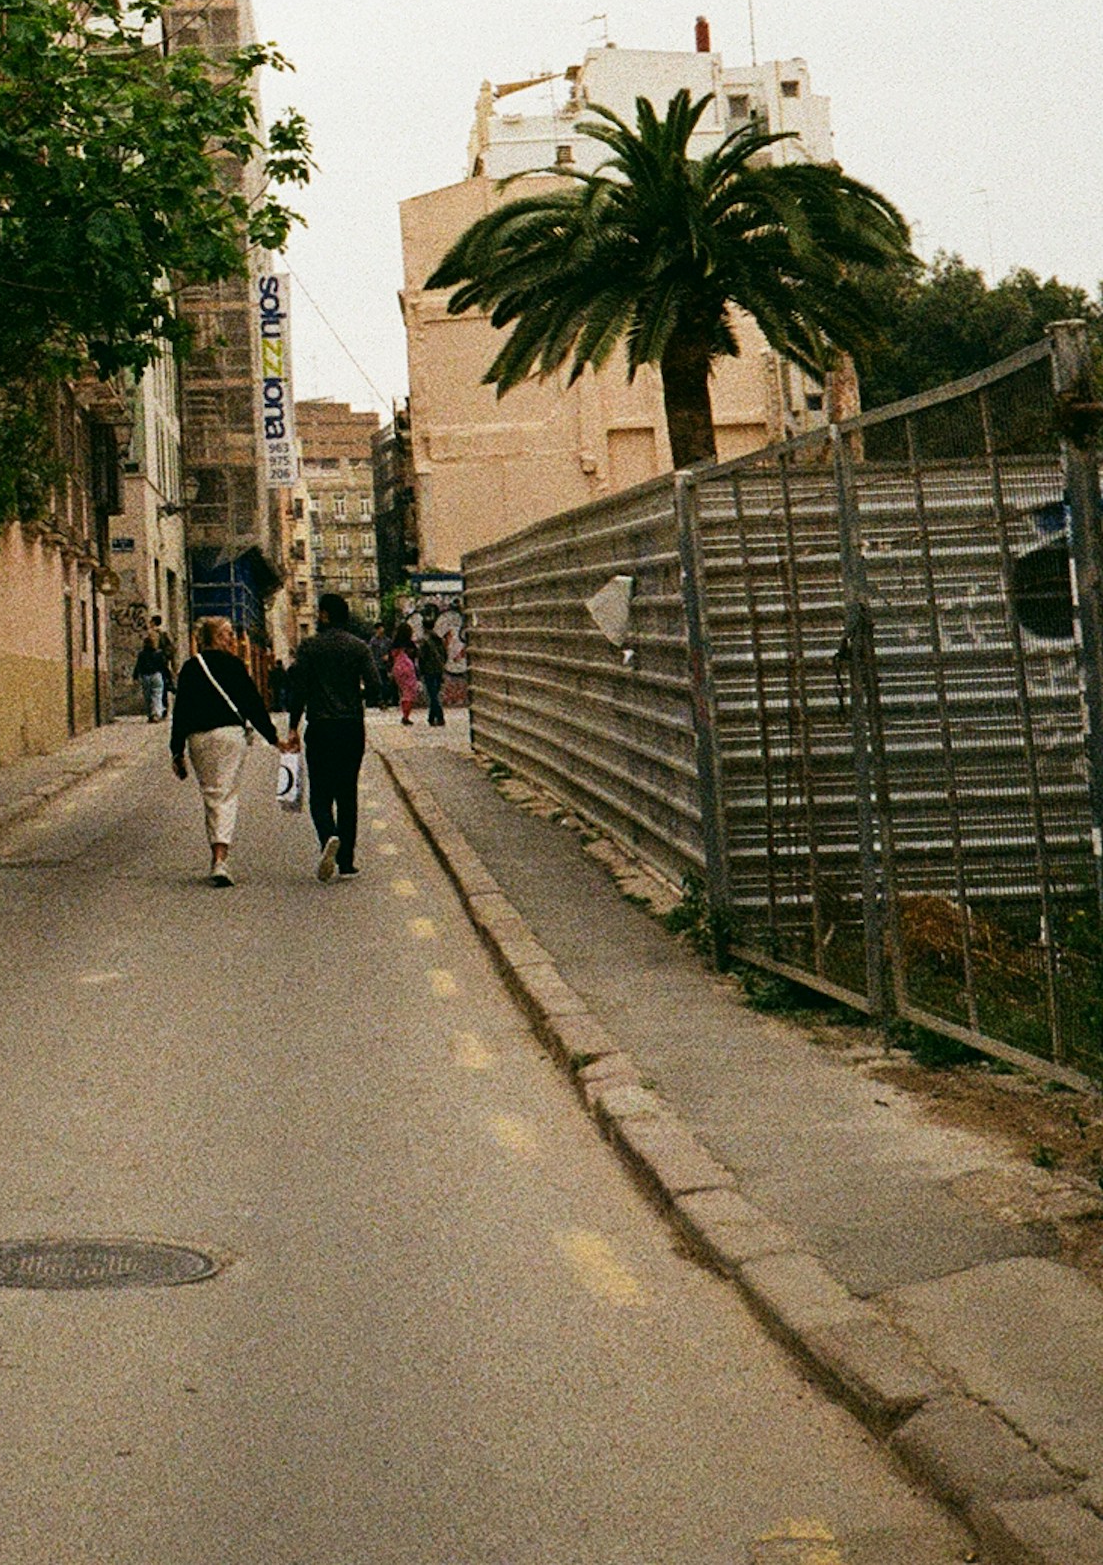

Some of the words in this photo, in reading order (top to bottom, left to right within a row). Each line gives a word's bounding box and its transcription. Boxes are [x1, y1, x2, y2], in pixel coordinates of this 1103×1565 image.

[259, 275, 288, 441] soluzziona
[268, 442, 291, 454] 963
[268, 455, 290, 467] 975
[269, 468, 291, 480] 206
